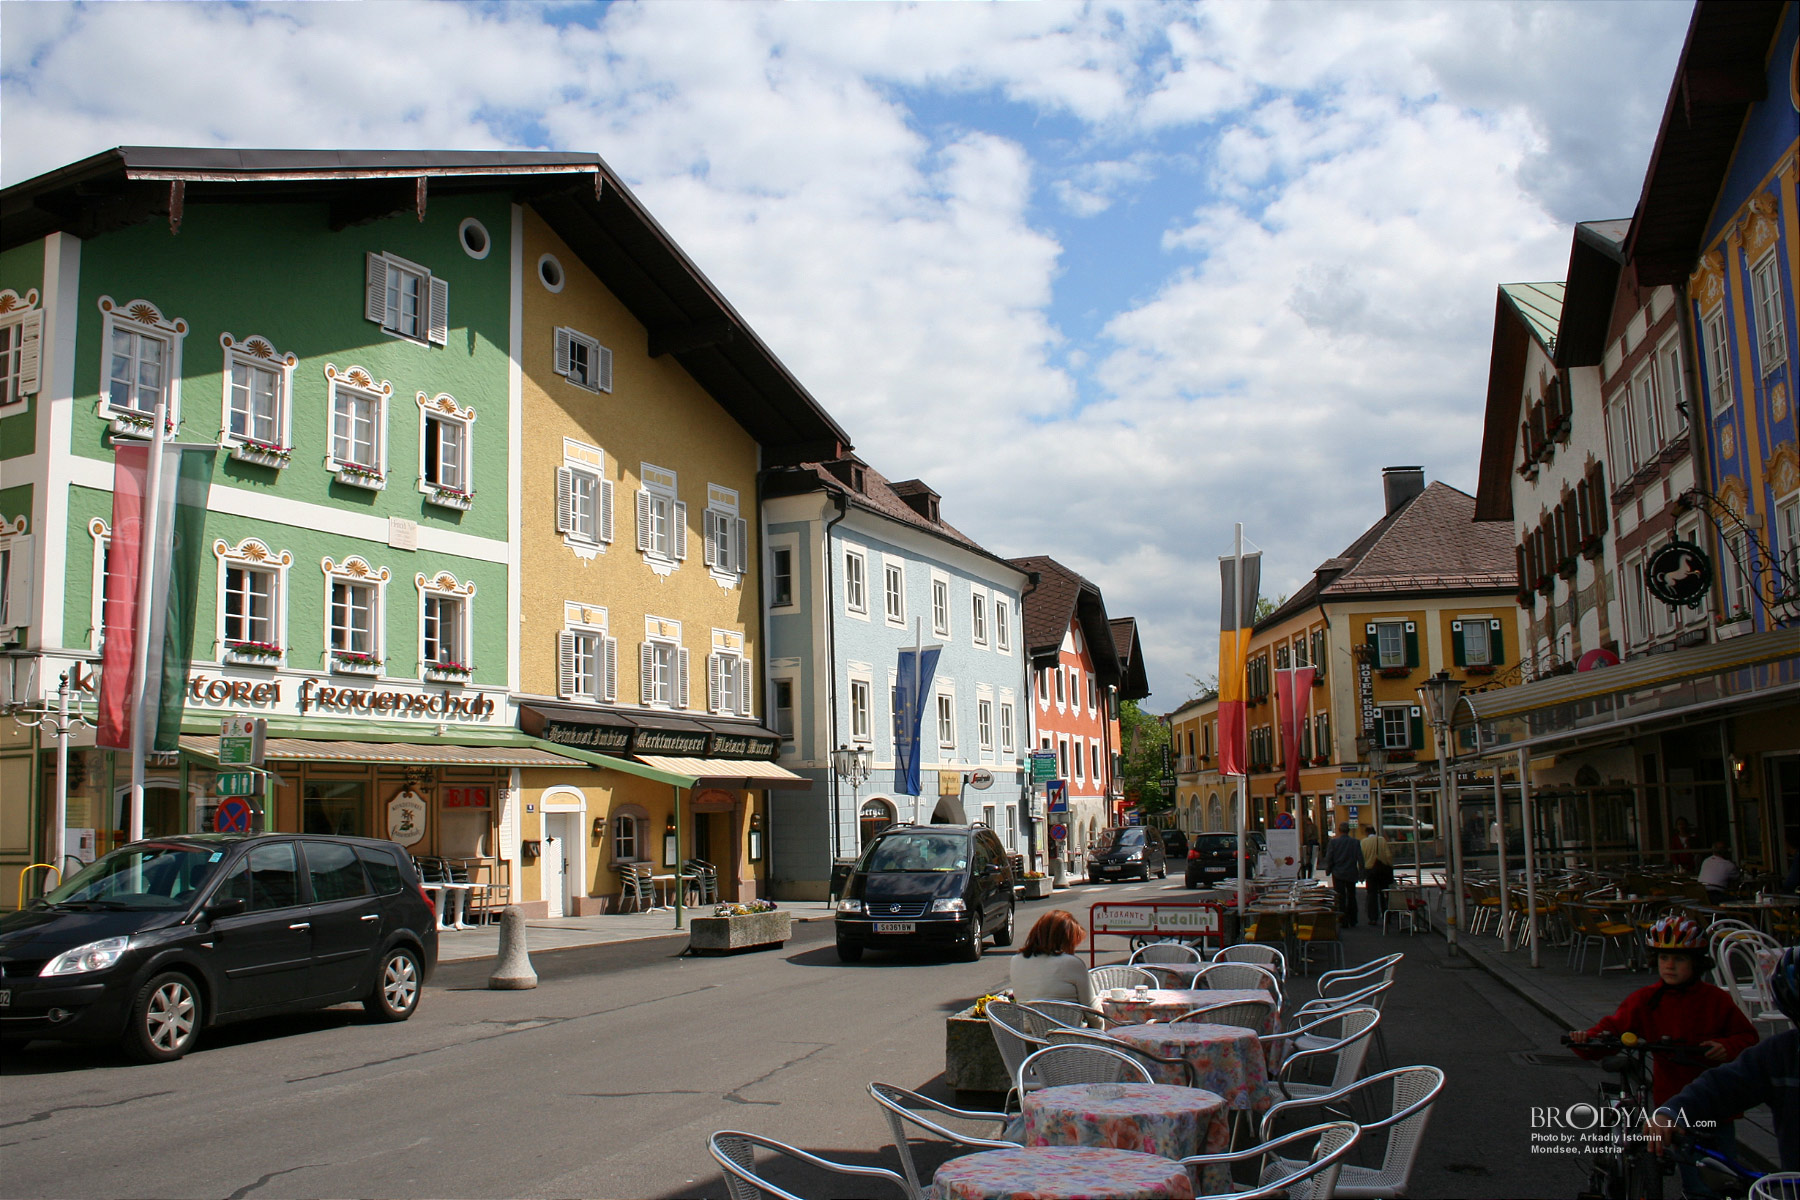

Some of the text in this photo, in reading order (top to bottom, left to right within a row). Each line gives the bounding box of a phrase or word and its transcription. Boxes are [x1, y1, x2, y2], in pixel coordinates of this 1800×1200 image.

[302, 678, 494, 716] frauenschuh
[1361, 664, 1374, 729] HOTEL KRONE
[448, 788, 487, 807] EIS
[499, 790, 511, 799] EIS
[1097, 910, 1144, 920] RISTORANTE
